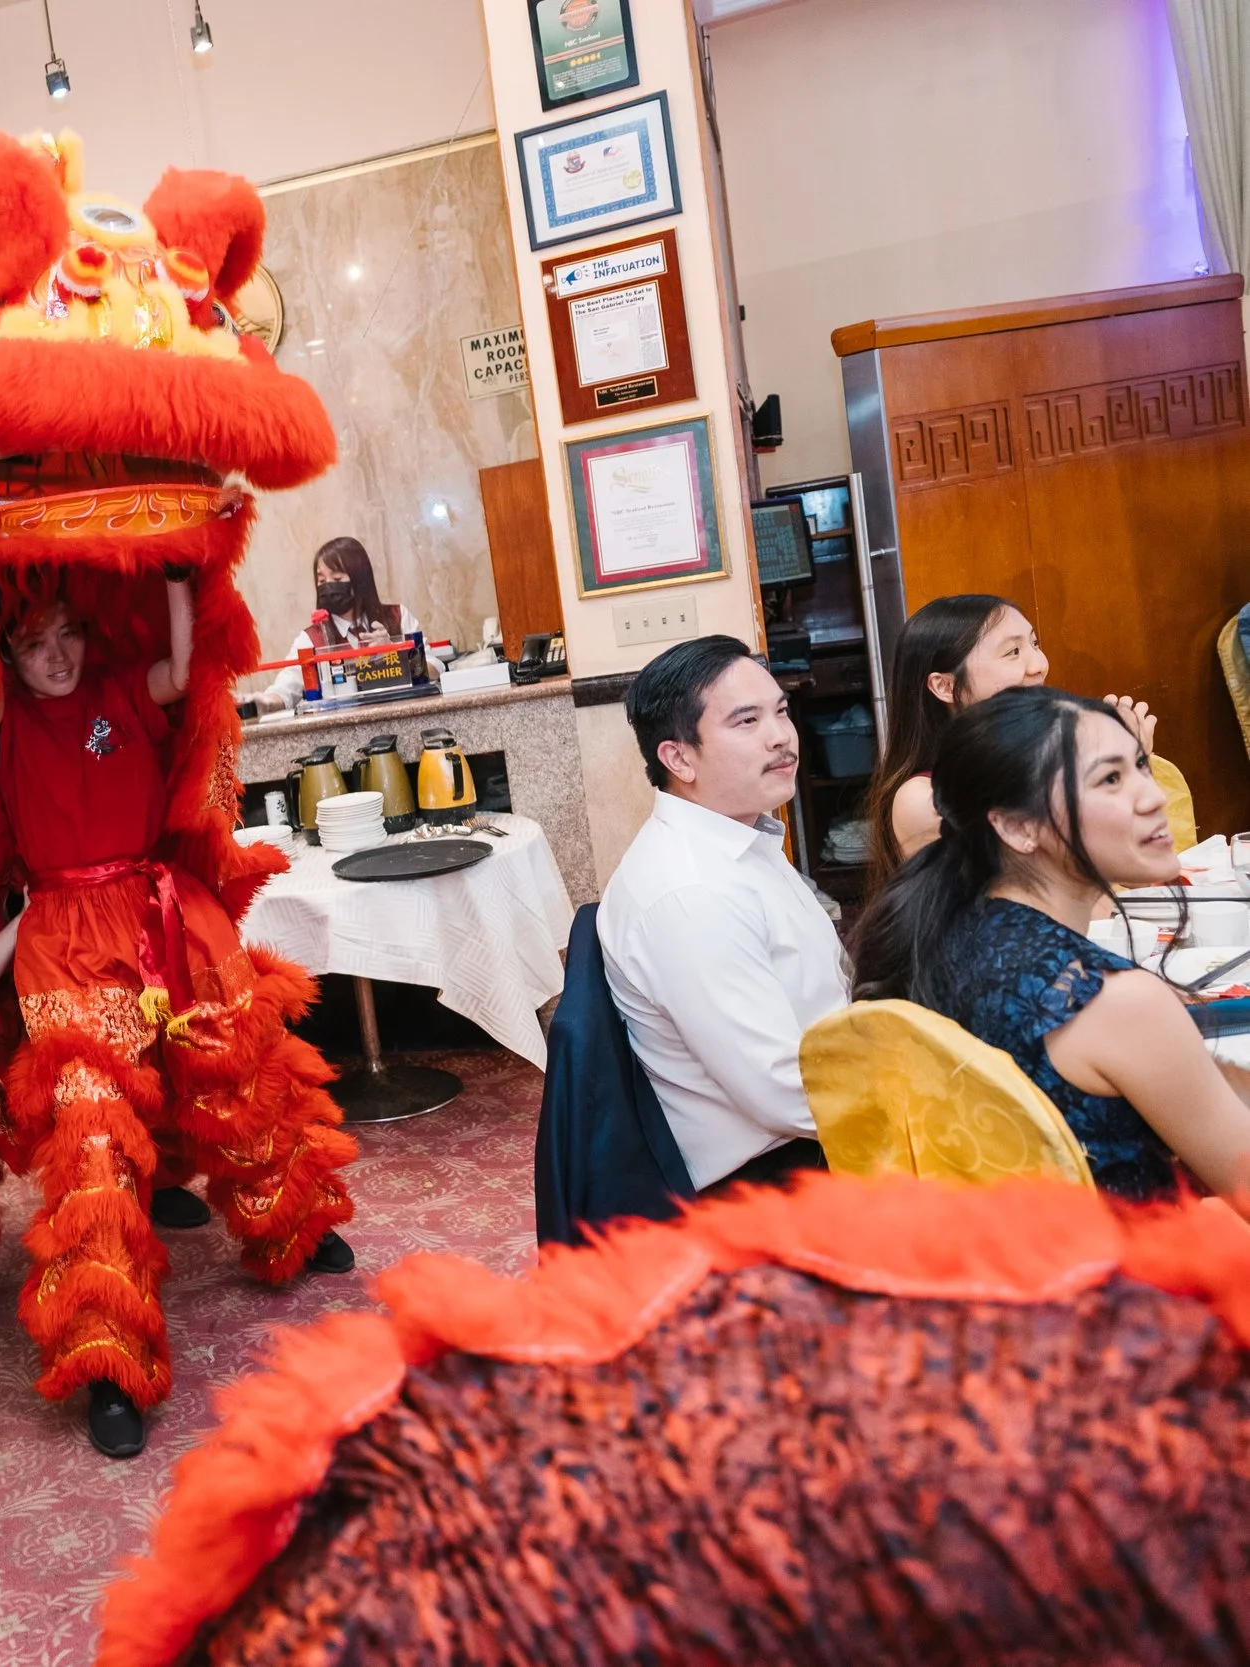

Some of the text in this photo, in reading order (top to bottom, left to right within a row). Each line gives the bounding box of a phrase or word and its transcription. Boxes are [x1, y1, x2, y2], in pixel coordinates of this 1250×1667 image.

[592, 259, 609, 270] THE
[594, 255, 660, 279] INFATUATION
[587, 299, 601, 307] Best
[603, 294, 624, 303] Places
[634, 288, 644, 296] Eat
[601, 301, 624, 310] Gabriel
[626, 296, 645, 305] Valley
[356, 666, 403, 682] CASHIER
